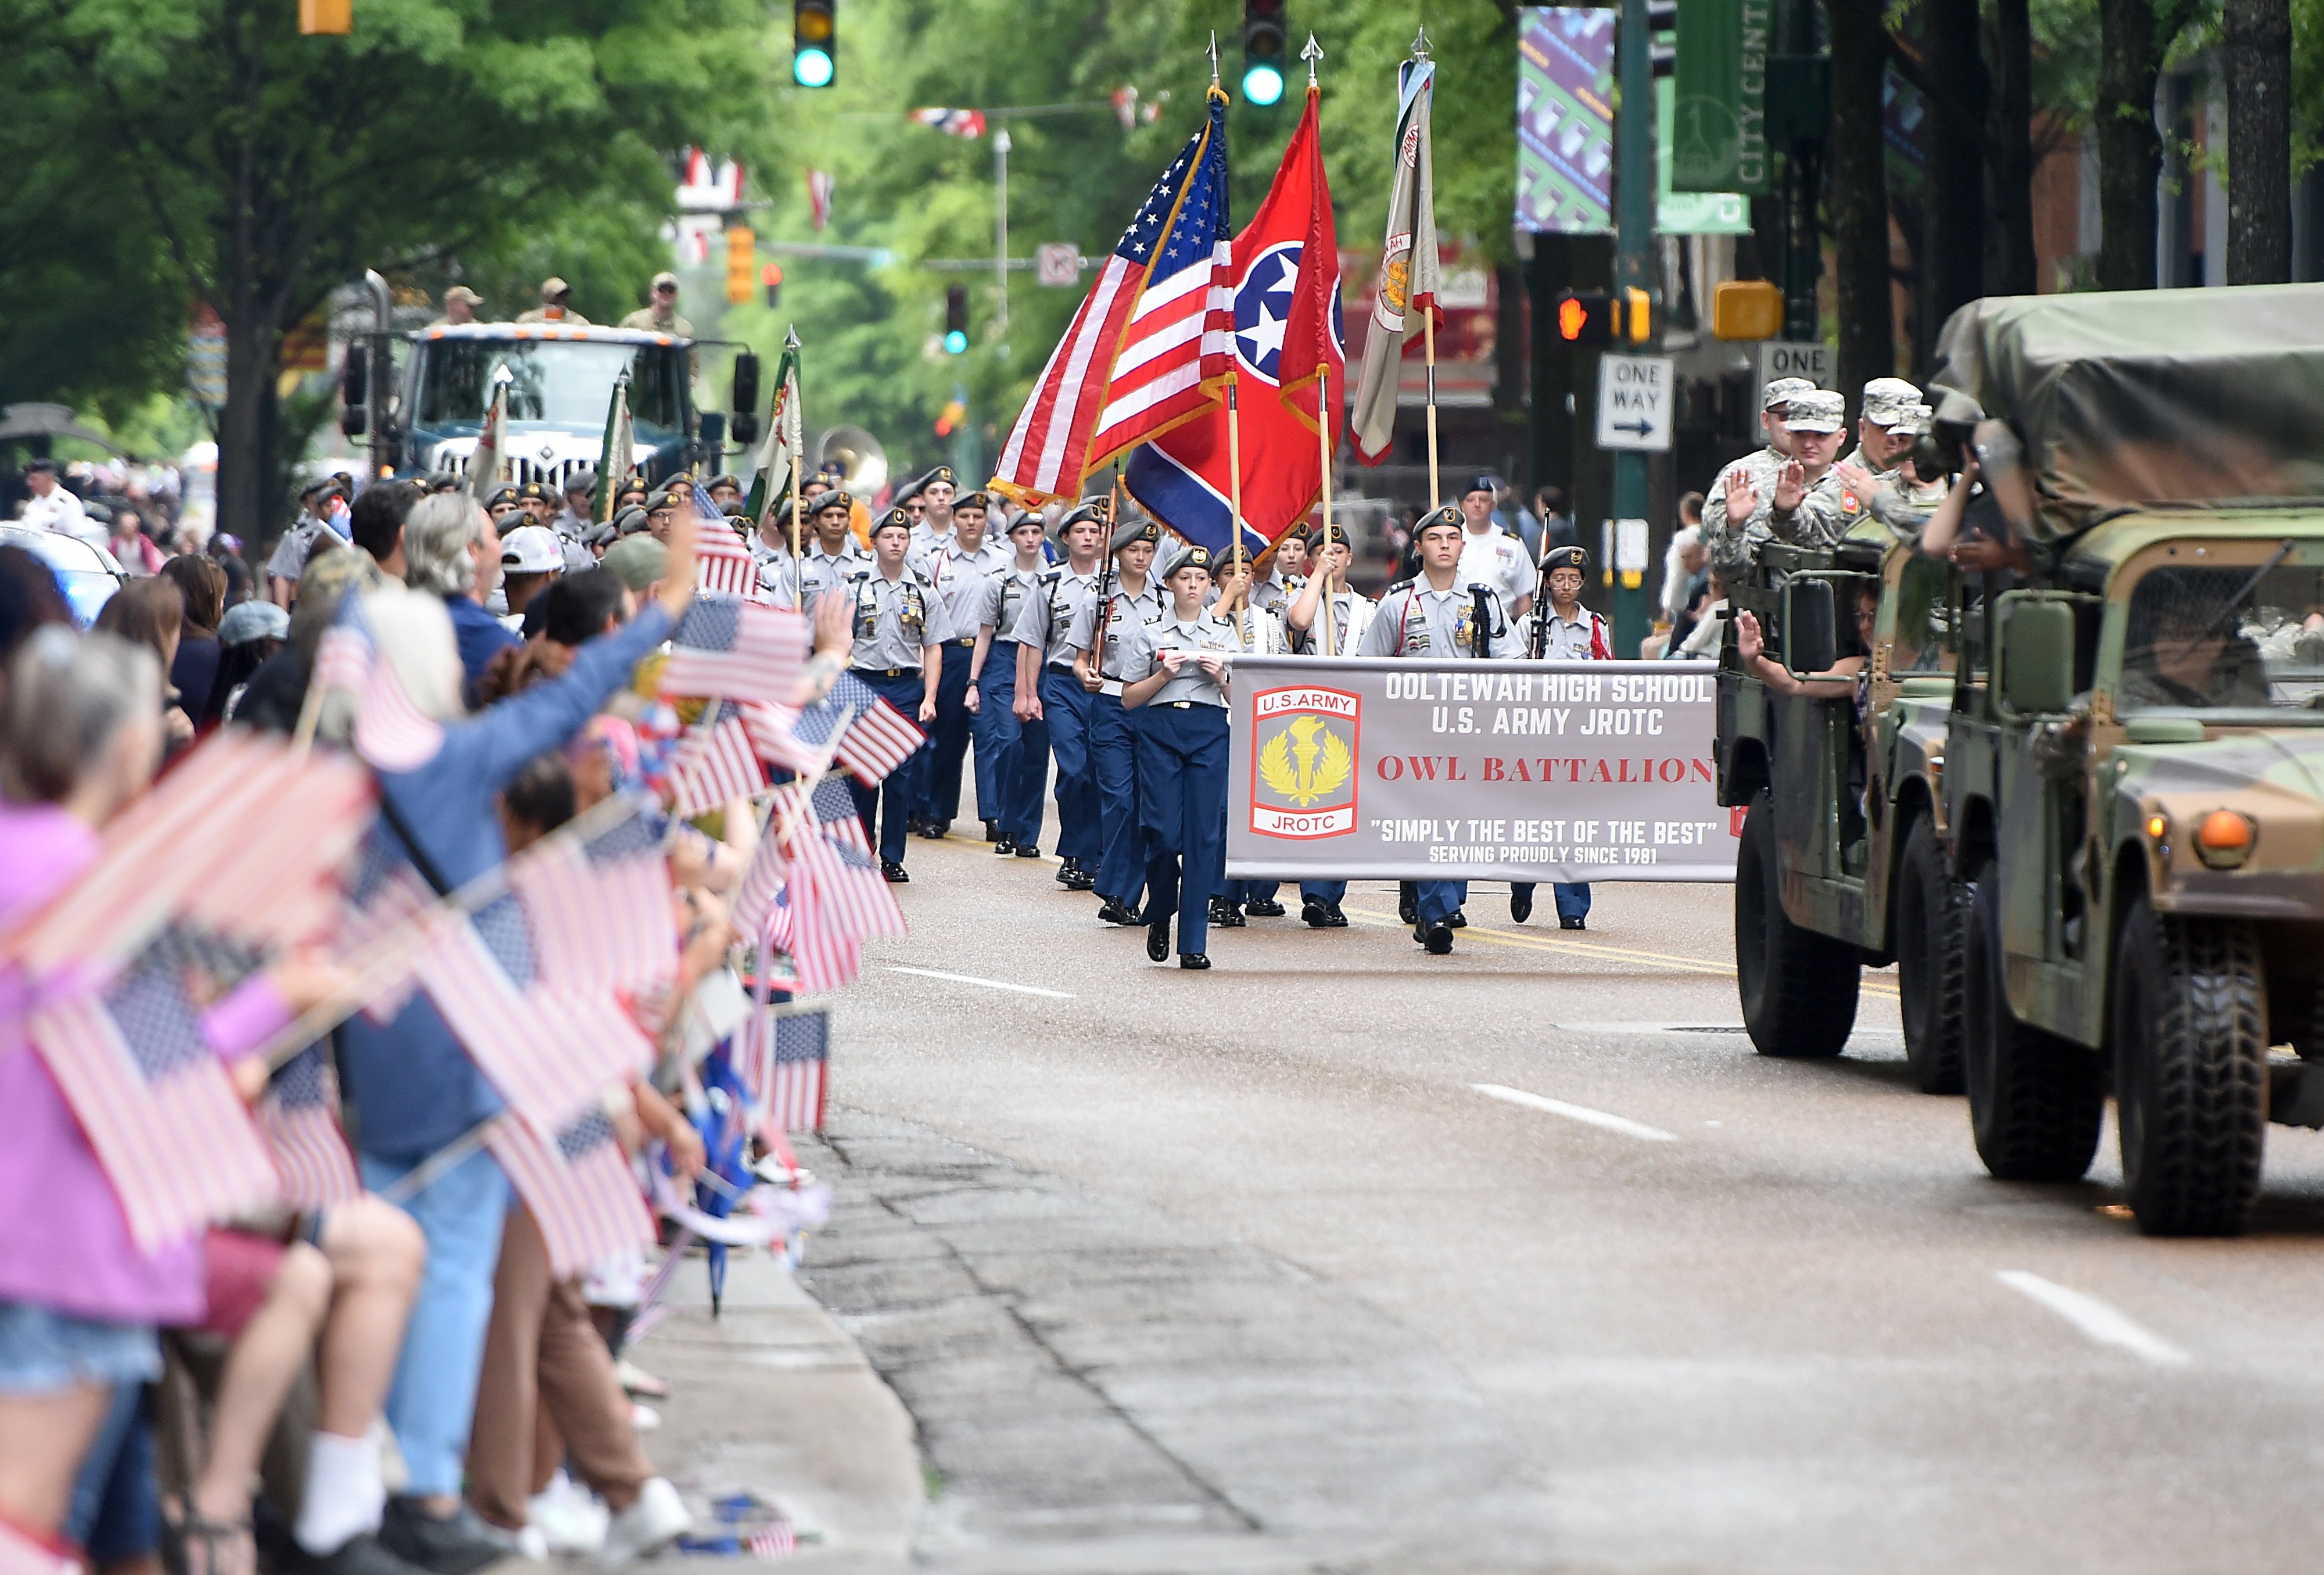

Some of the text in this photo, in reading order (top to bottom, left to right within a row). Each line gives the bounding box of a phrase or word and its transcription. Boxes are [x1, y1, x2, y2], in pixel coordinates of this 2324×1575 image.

[1739, 0, 1767, 183] CITY CENT
[1773, 349, 1825, 371] ONE
[1616, 363, 1660, 383] ONE
[1613, 389, 1660, 410] WAY
[1386, 672, 1712, 702] OOLTEWAH HIGH SCHOOL
[1432, 706, 1663, 735] U.S. ARMY JROTC
[1377, 755, 1713, 783] OWL BATTALION
[1272, 815, 1335, 831] JROTC
[1371, 819, 1460, 842] "SIMPLY
[1468, 820, 1506, 842] THE
[1514, 820, 1566, 843] BEST
[1573, 820, 1599, 843] OF
[1608, 820, 1646, 844] THE
[1654, 821, 1717, 845] BEST"
[1429, 845, 1656, 864] SERVING PROUDLY SINCE 1981
